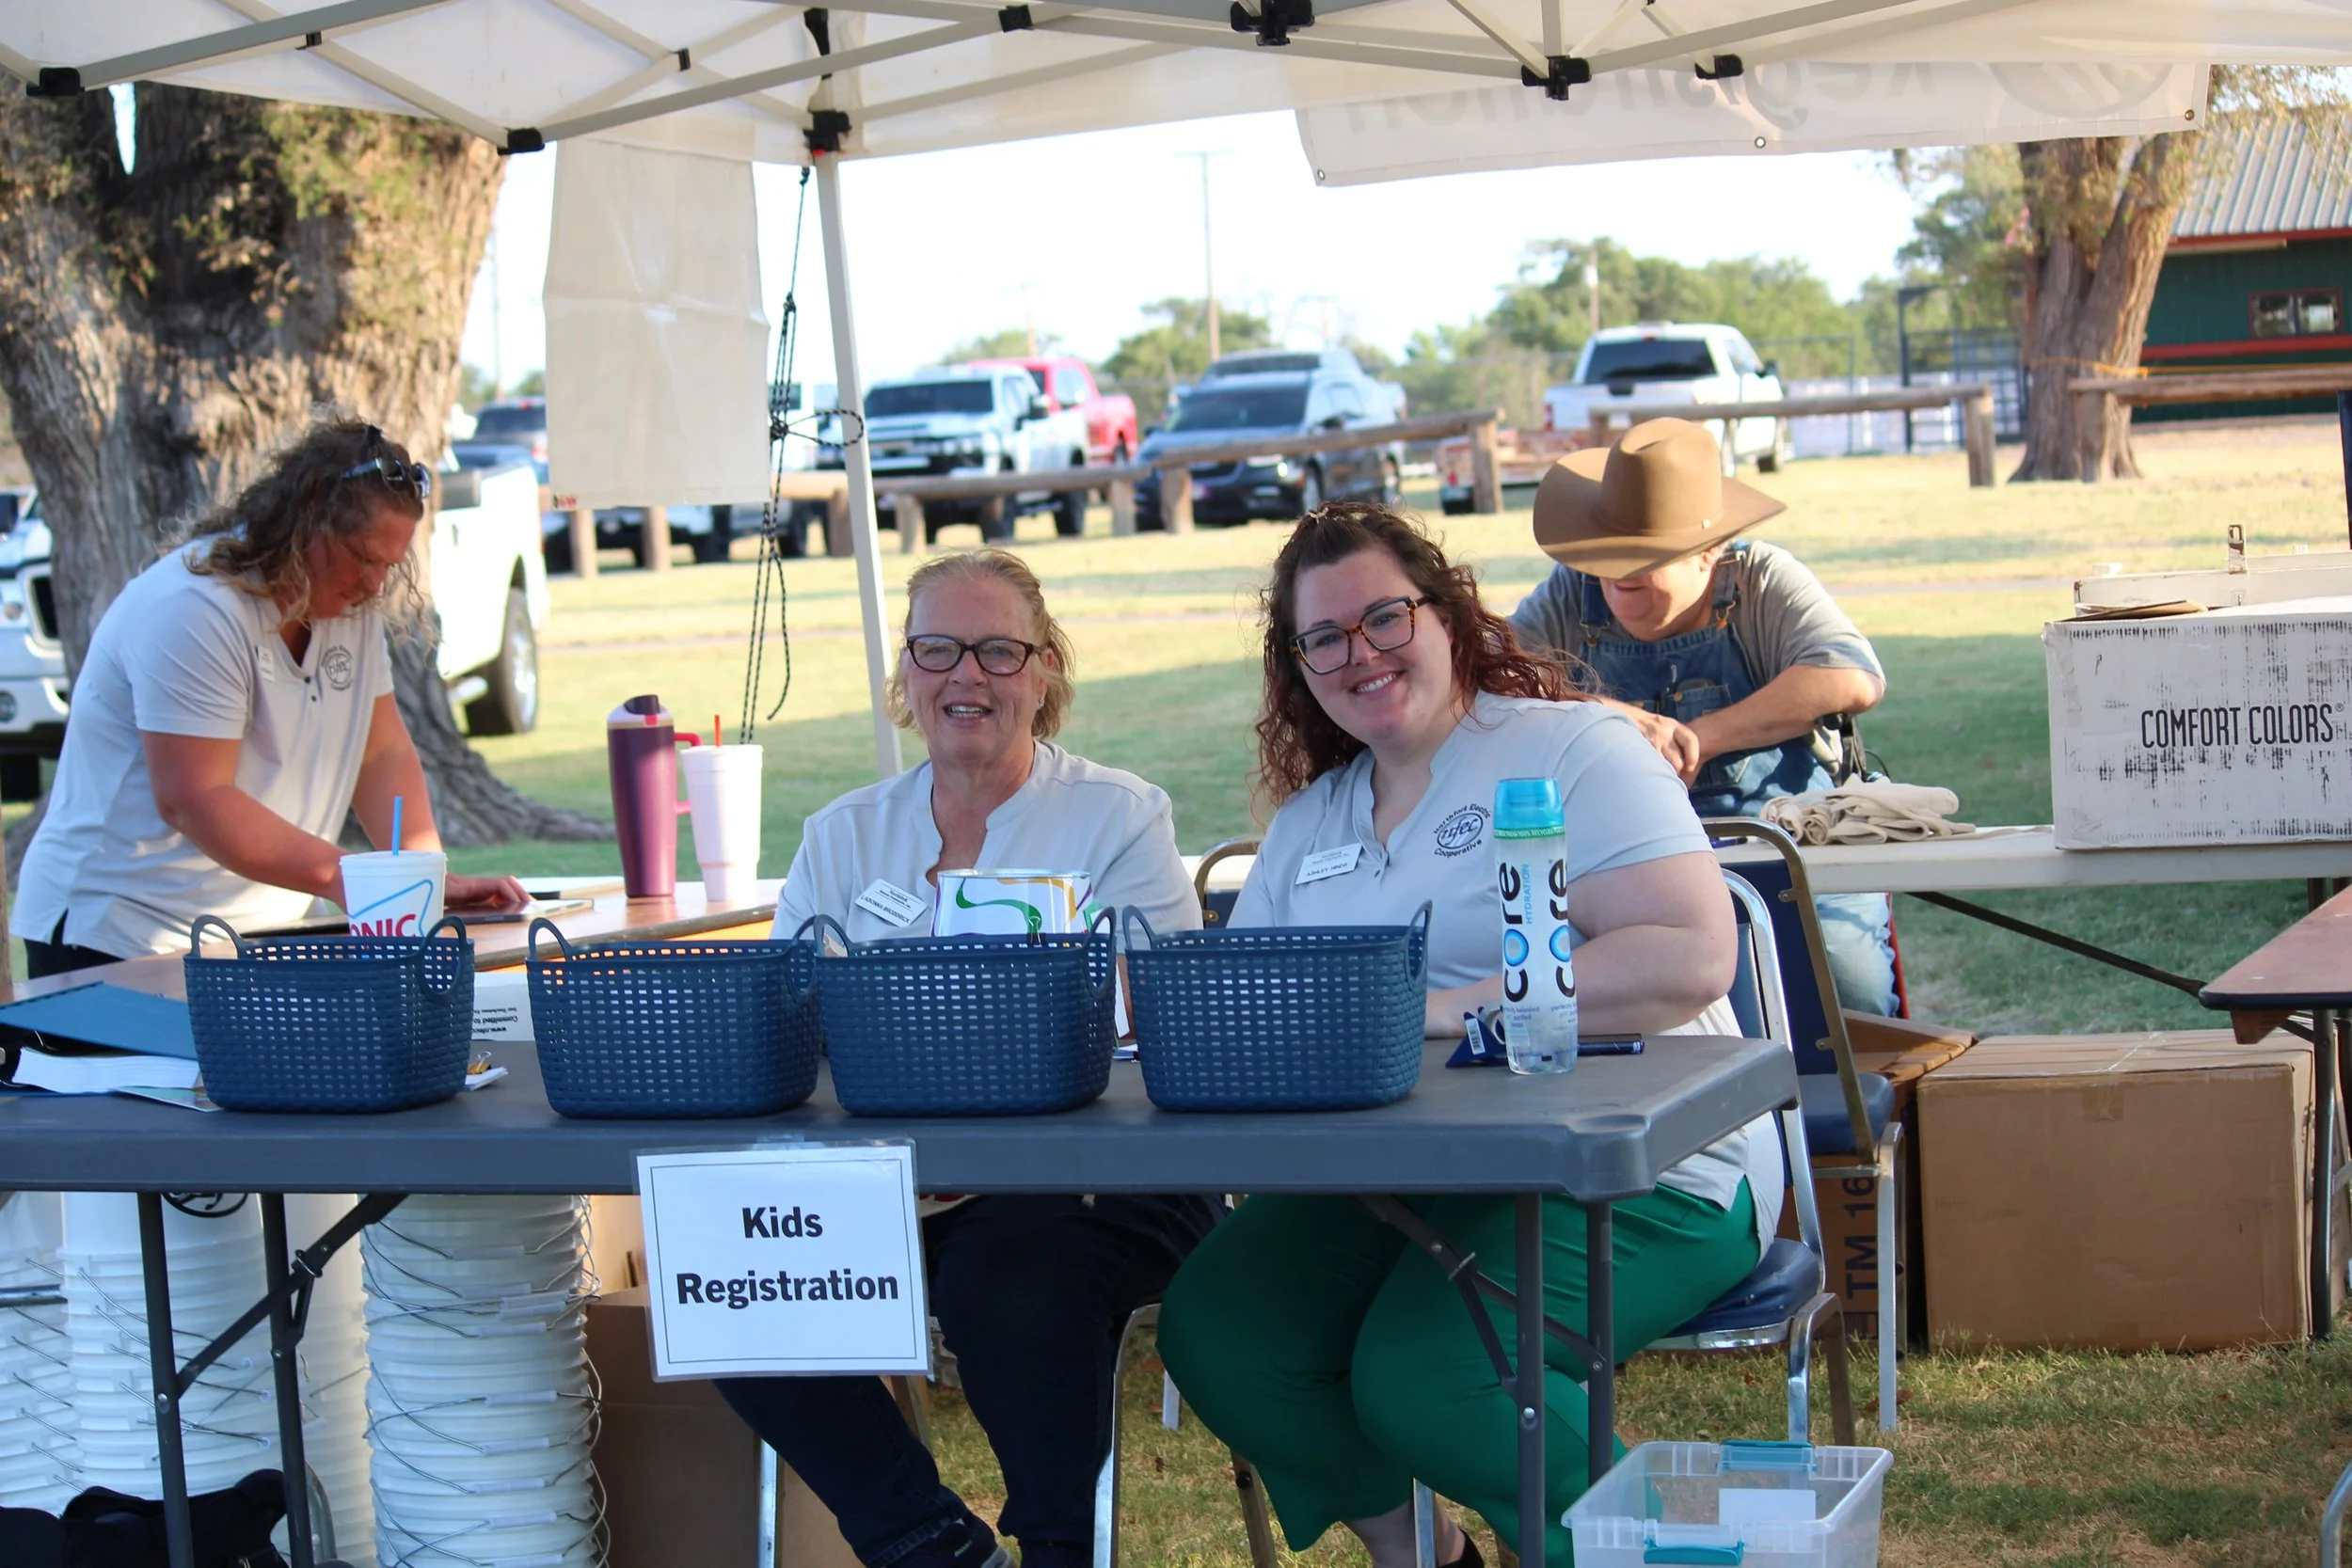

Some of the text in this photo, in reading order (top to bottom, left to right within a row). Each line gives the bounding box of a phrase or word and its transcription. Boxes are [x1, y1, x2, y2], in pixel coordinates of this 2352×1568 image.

[2141, 706, 2241, 748] COMFORT
[1434, 839, 1483, 858] Cooperative
[1521, 863, 1534, 924] HYDRATION
[1499, 863, 1530, 1003] core
[1549, 858, 1576, 998] core
[482, 1016, 518, 1024] Committed
[741, 1206, 823, 1239] Kids
[676, 1268, 898, 1309] Registration
[1845, 1236, 1879, 1299] TM
